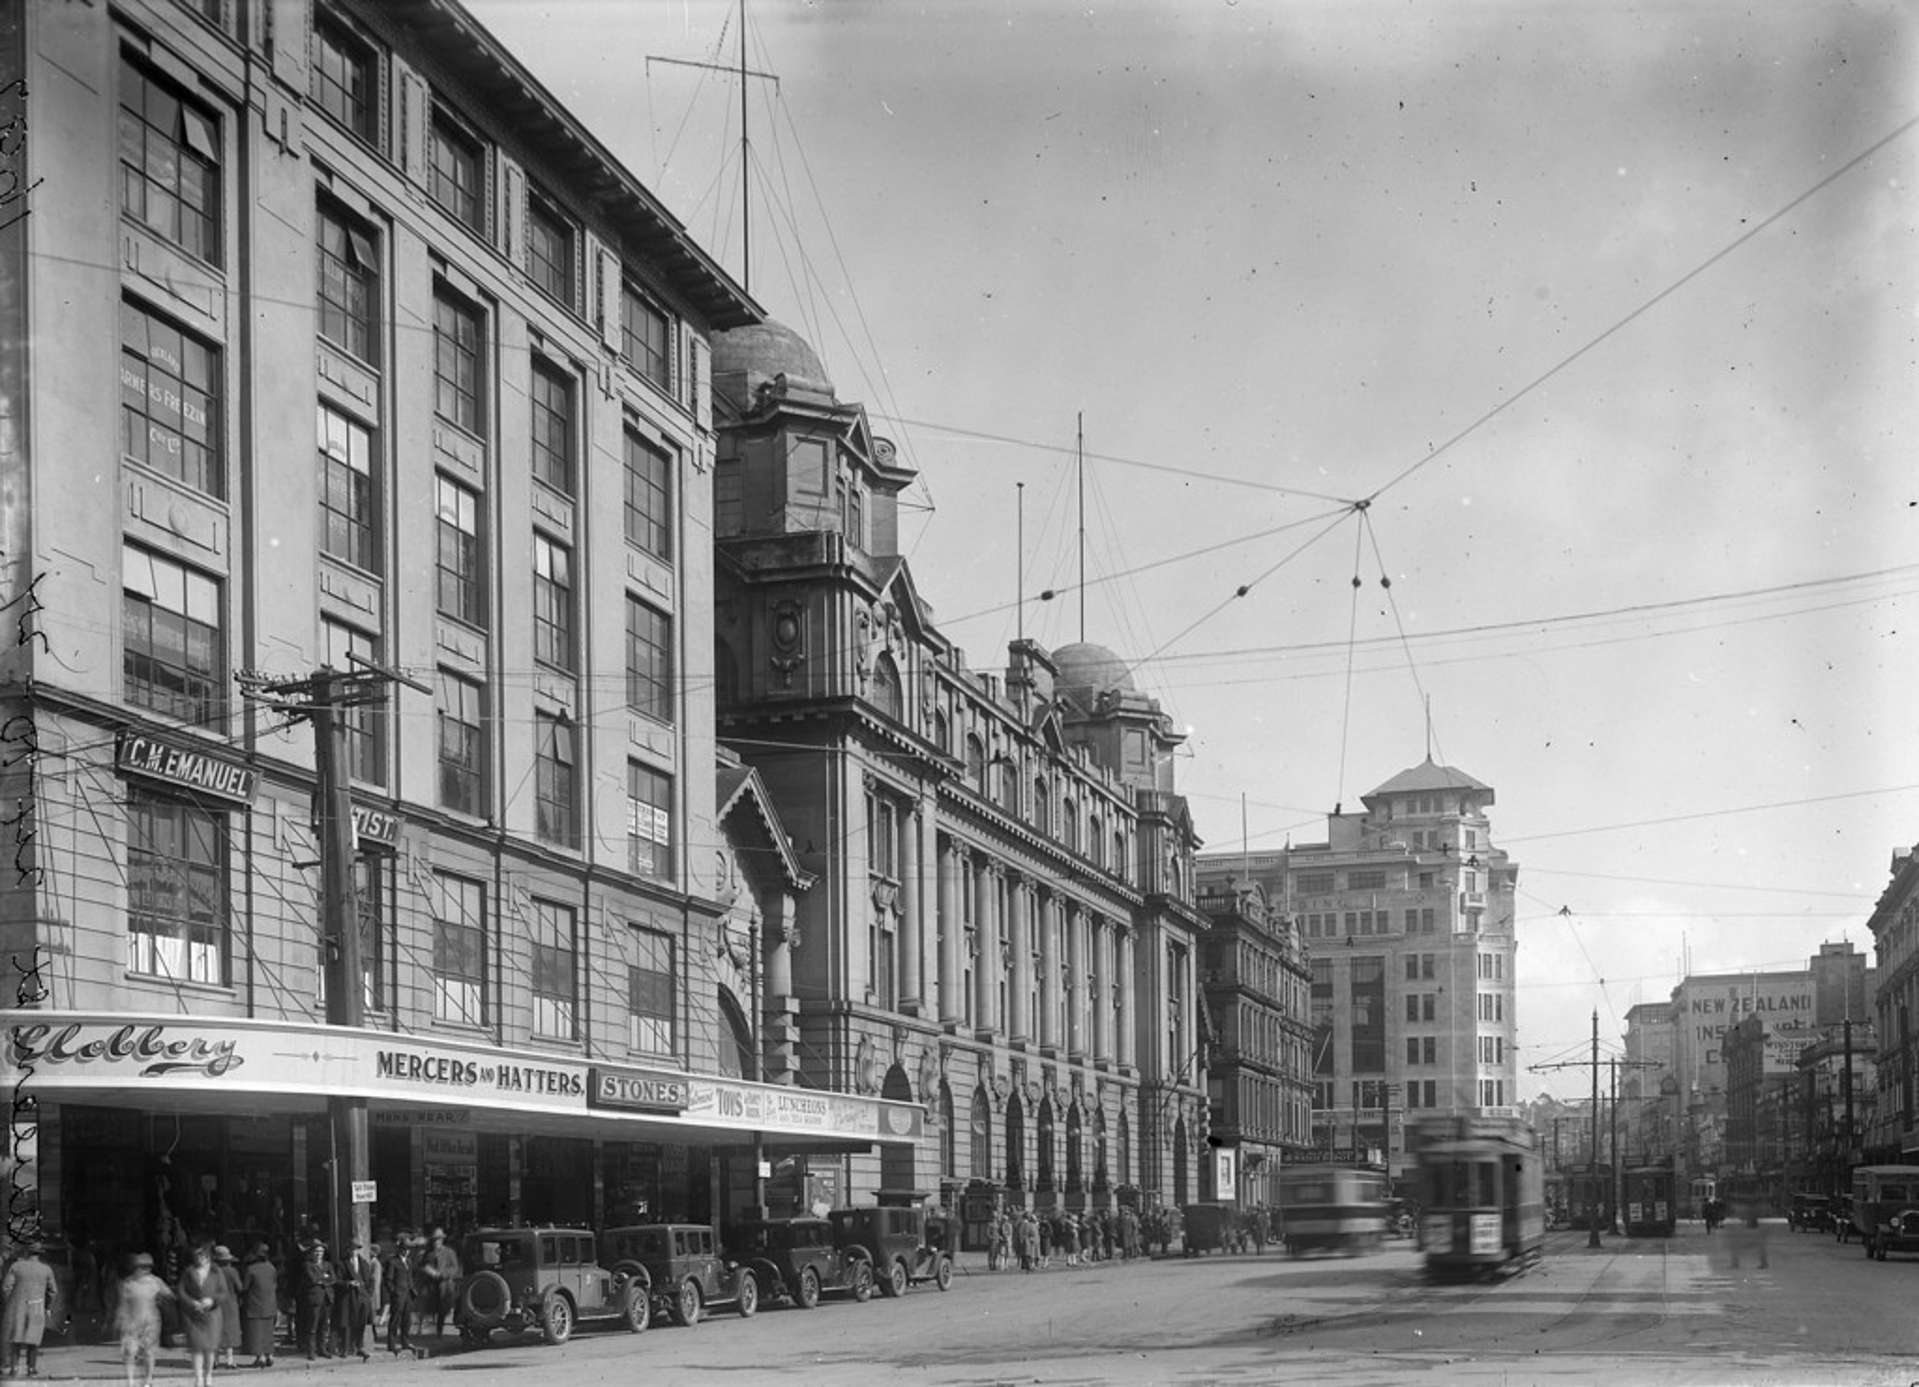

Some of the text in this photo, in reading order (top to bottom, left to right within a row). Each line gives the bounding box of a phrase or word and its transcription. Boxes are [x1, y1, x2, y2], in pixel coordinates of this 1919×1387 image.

[164, 750, 247, 797] EMANUEL
[356, 808, 393, 840] TIST.
[1692, 995, 1811, 1014] NEW ZEALAND
[376, 1050, 478, 1086] MERCERS
[480, 1067, 495, 1084] AND
[603, 1077, 679, 1103] STONES
